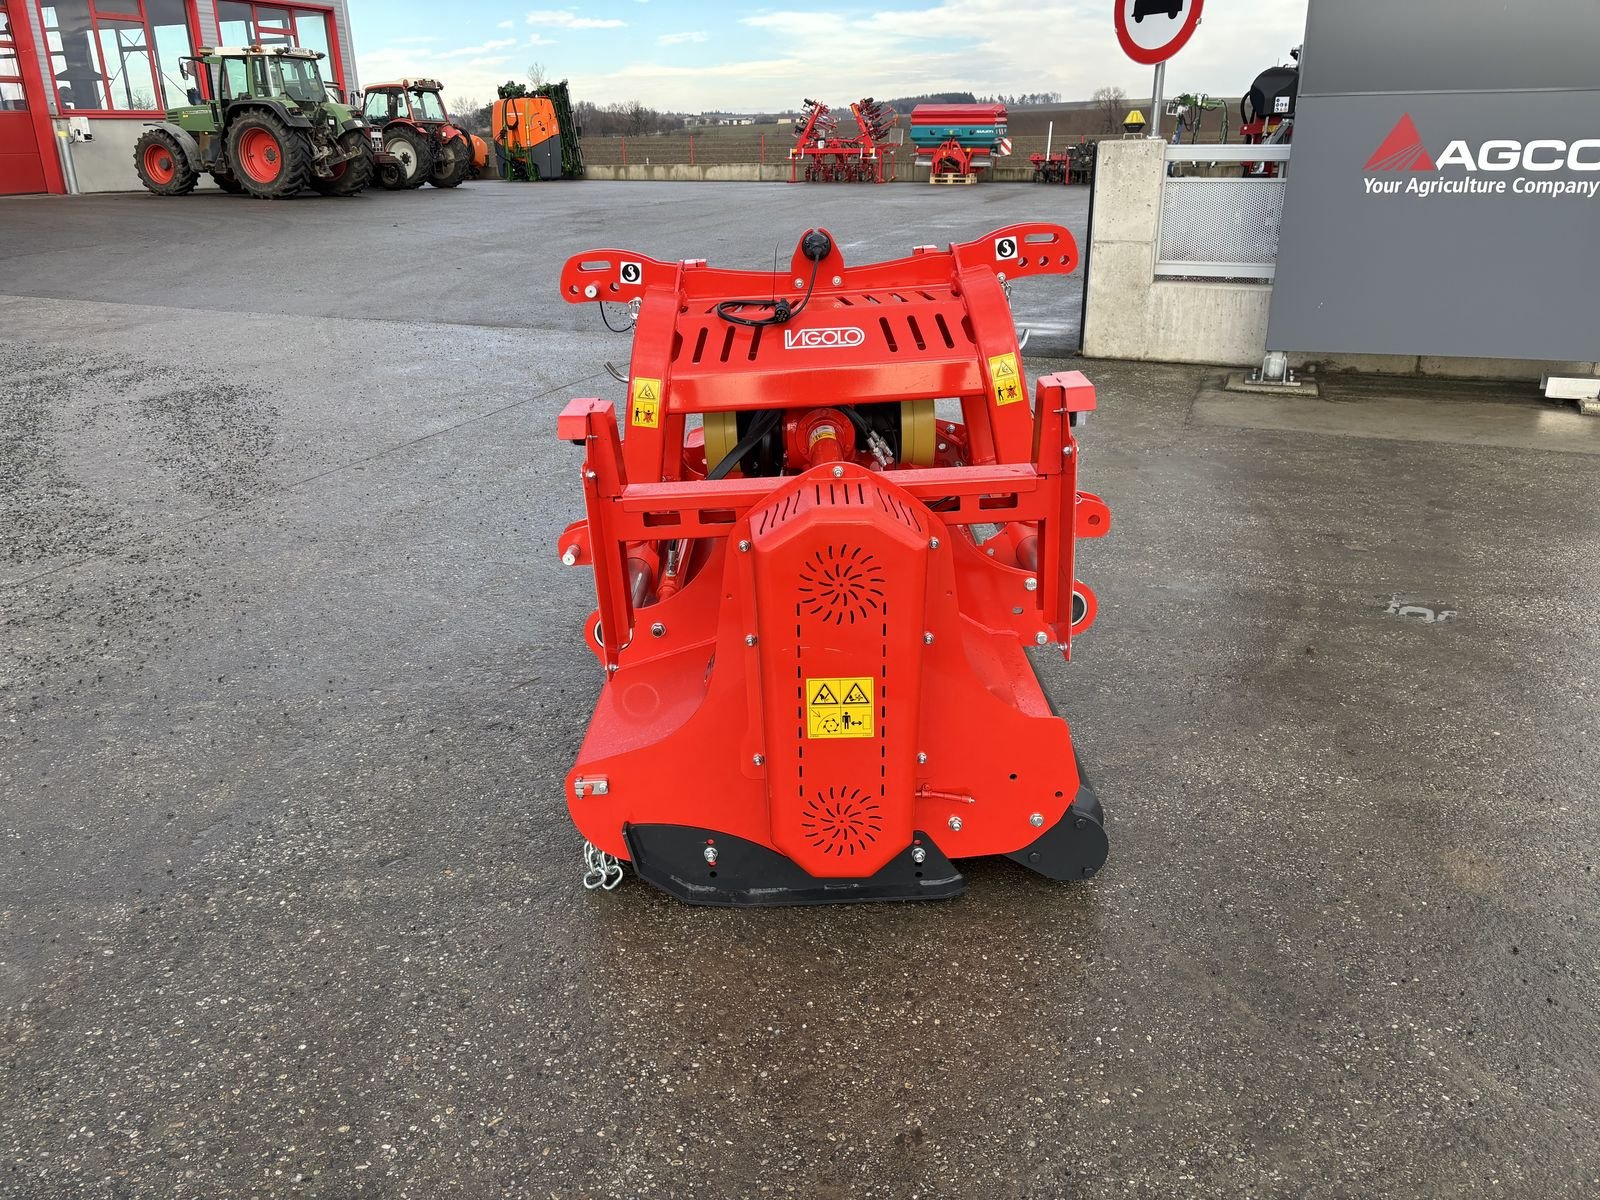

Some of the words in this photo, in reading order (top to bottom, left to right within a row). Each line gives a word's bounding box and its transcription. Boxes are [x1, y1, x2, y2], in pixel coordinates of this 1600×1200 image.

[1435, 139, 1600, 171] AGCO
[1363, 177, 1402, 194] Your
[1405, 176, 1506, 197] Agriculture
[1512, 177, 1600, 198] Company
[784, 328, 862, 349] VIGOLO
